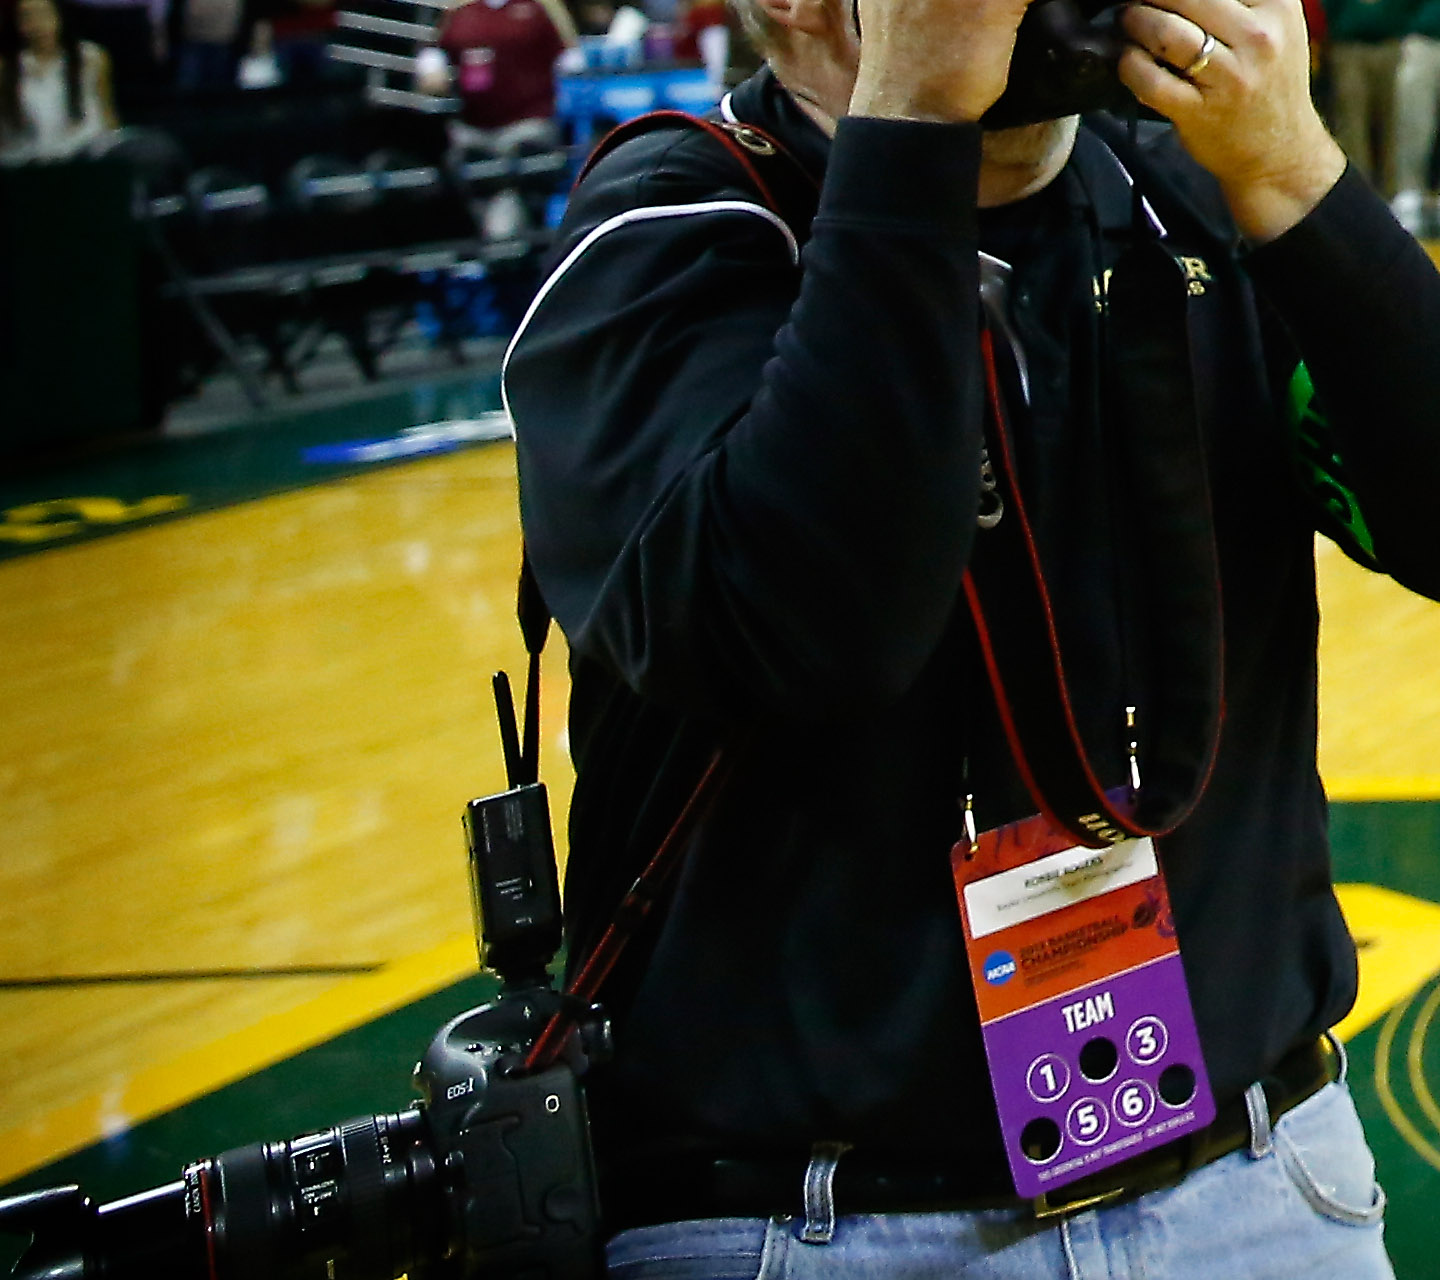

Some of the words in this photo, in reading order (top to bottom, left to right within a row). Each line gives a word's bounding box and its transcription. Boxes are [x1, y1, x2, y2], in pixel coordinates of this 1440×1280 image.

[1061, 991, 1115, 1034] TEAM
[1135, 1026, 1157, 1056] 3
[1040, 1064, 1058, 1092] 1
[1121, 1087, 1144, 1117] 6
[1077, 1105, 1099, 1137] 5
